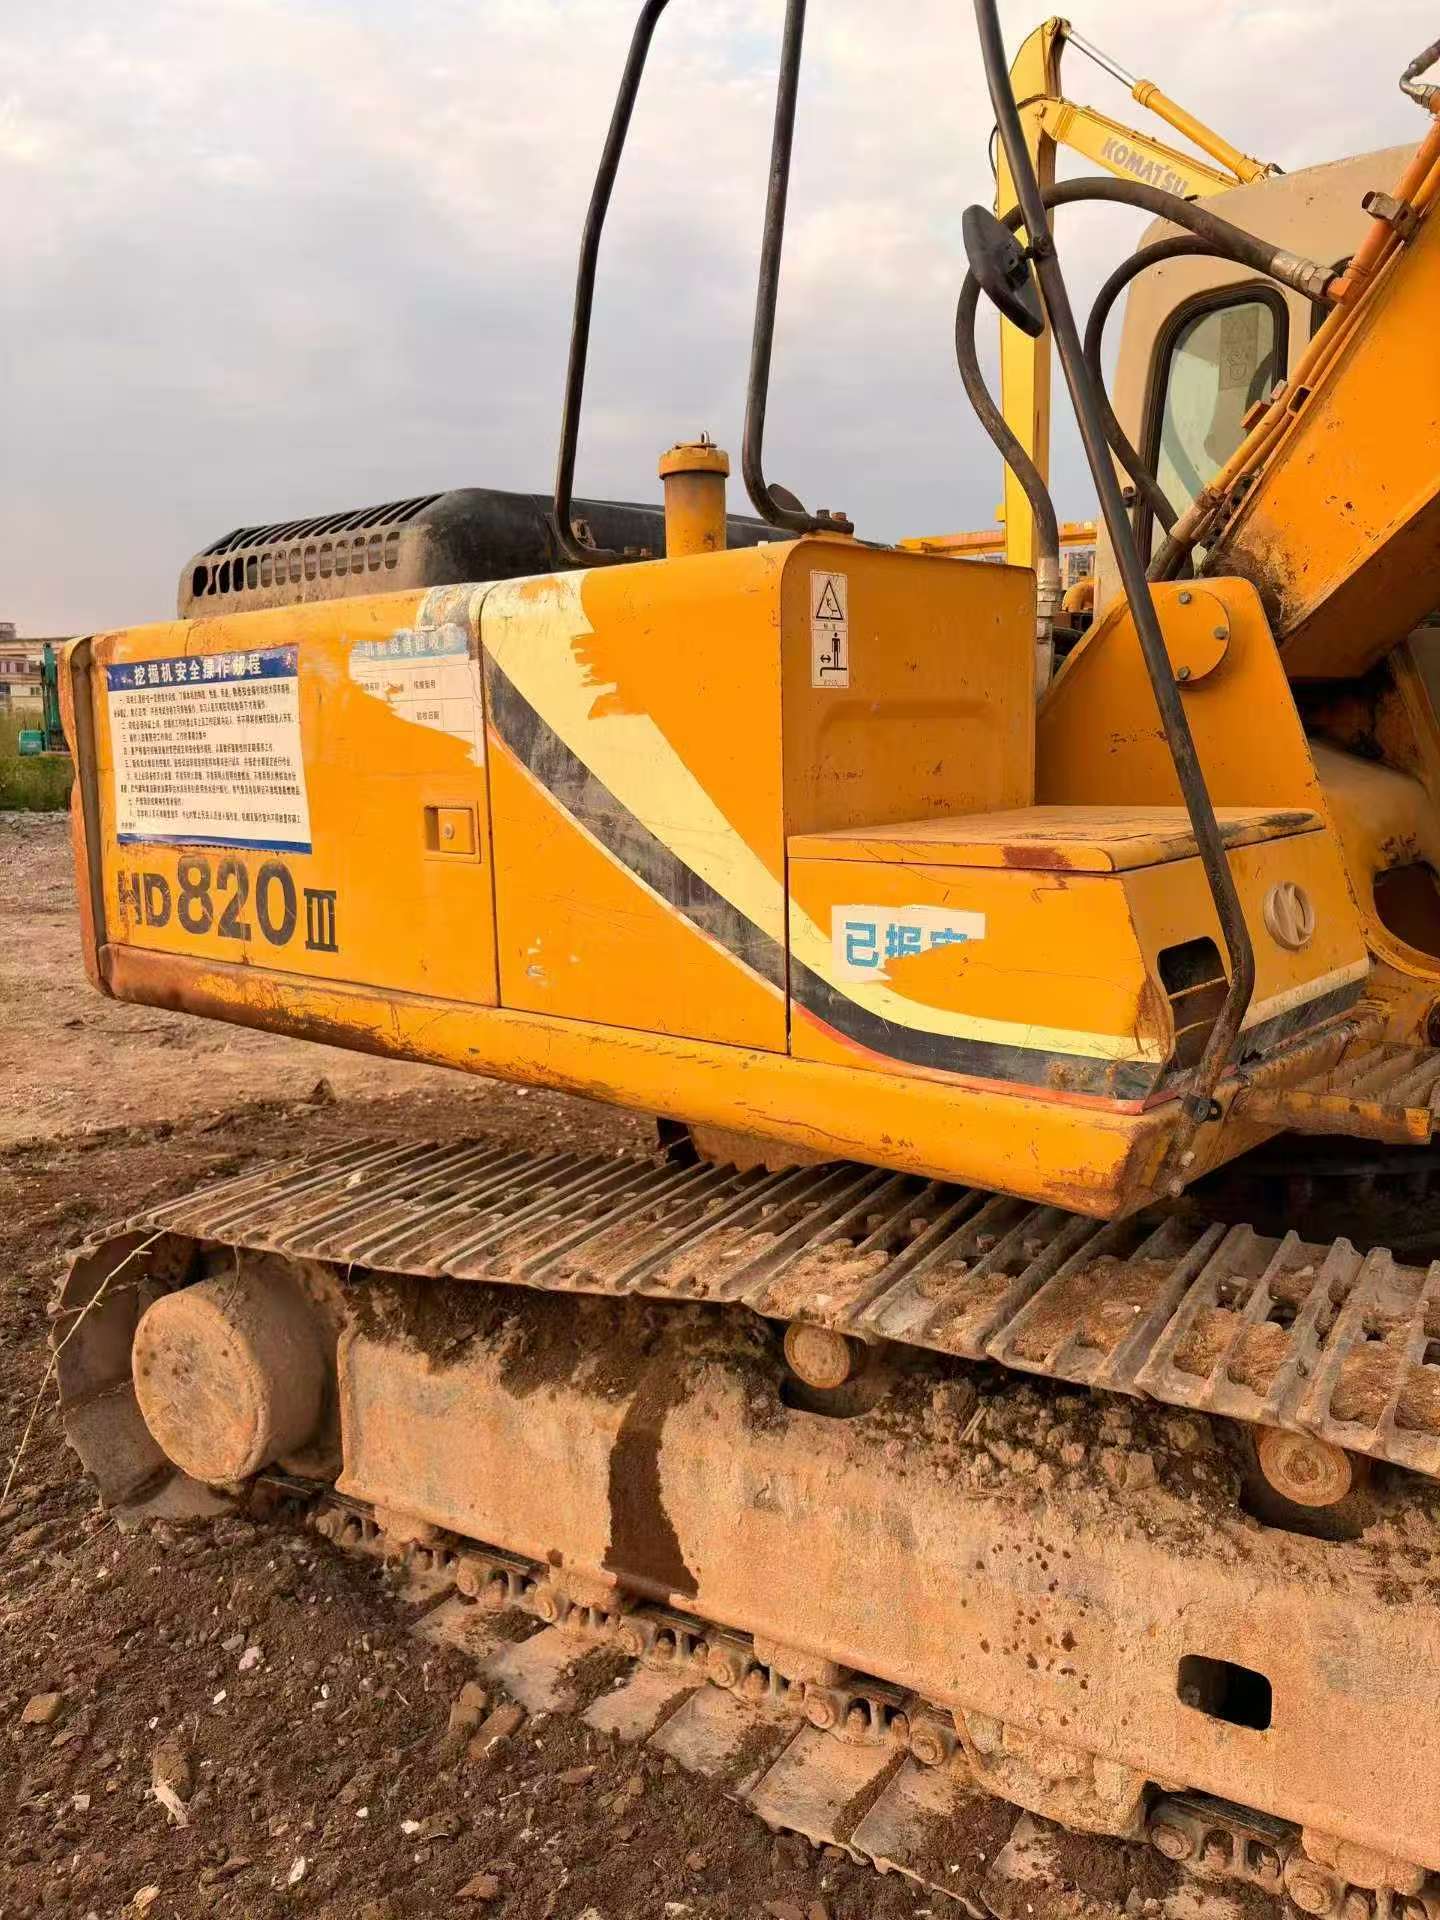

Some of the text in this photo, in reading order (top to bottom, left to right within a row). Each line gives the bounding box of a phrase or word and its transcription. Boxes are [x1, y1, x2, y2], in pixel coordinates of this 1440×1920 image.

[1102, 137, 1189, 195] KOMATSU
[134, 652, 262, 686] 挖掘机安全操作规程
[117, 855, 297, 946] HD820
